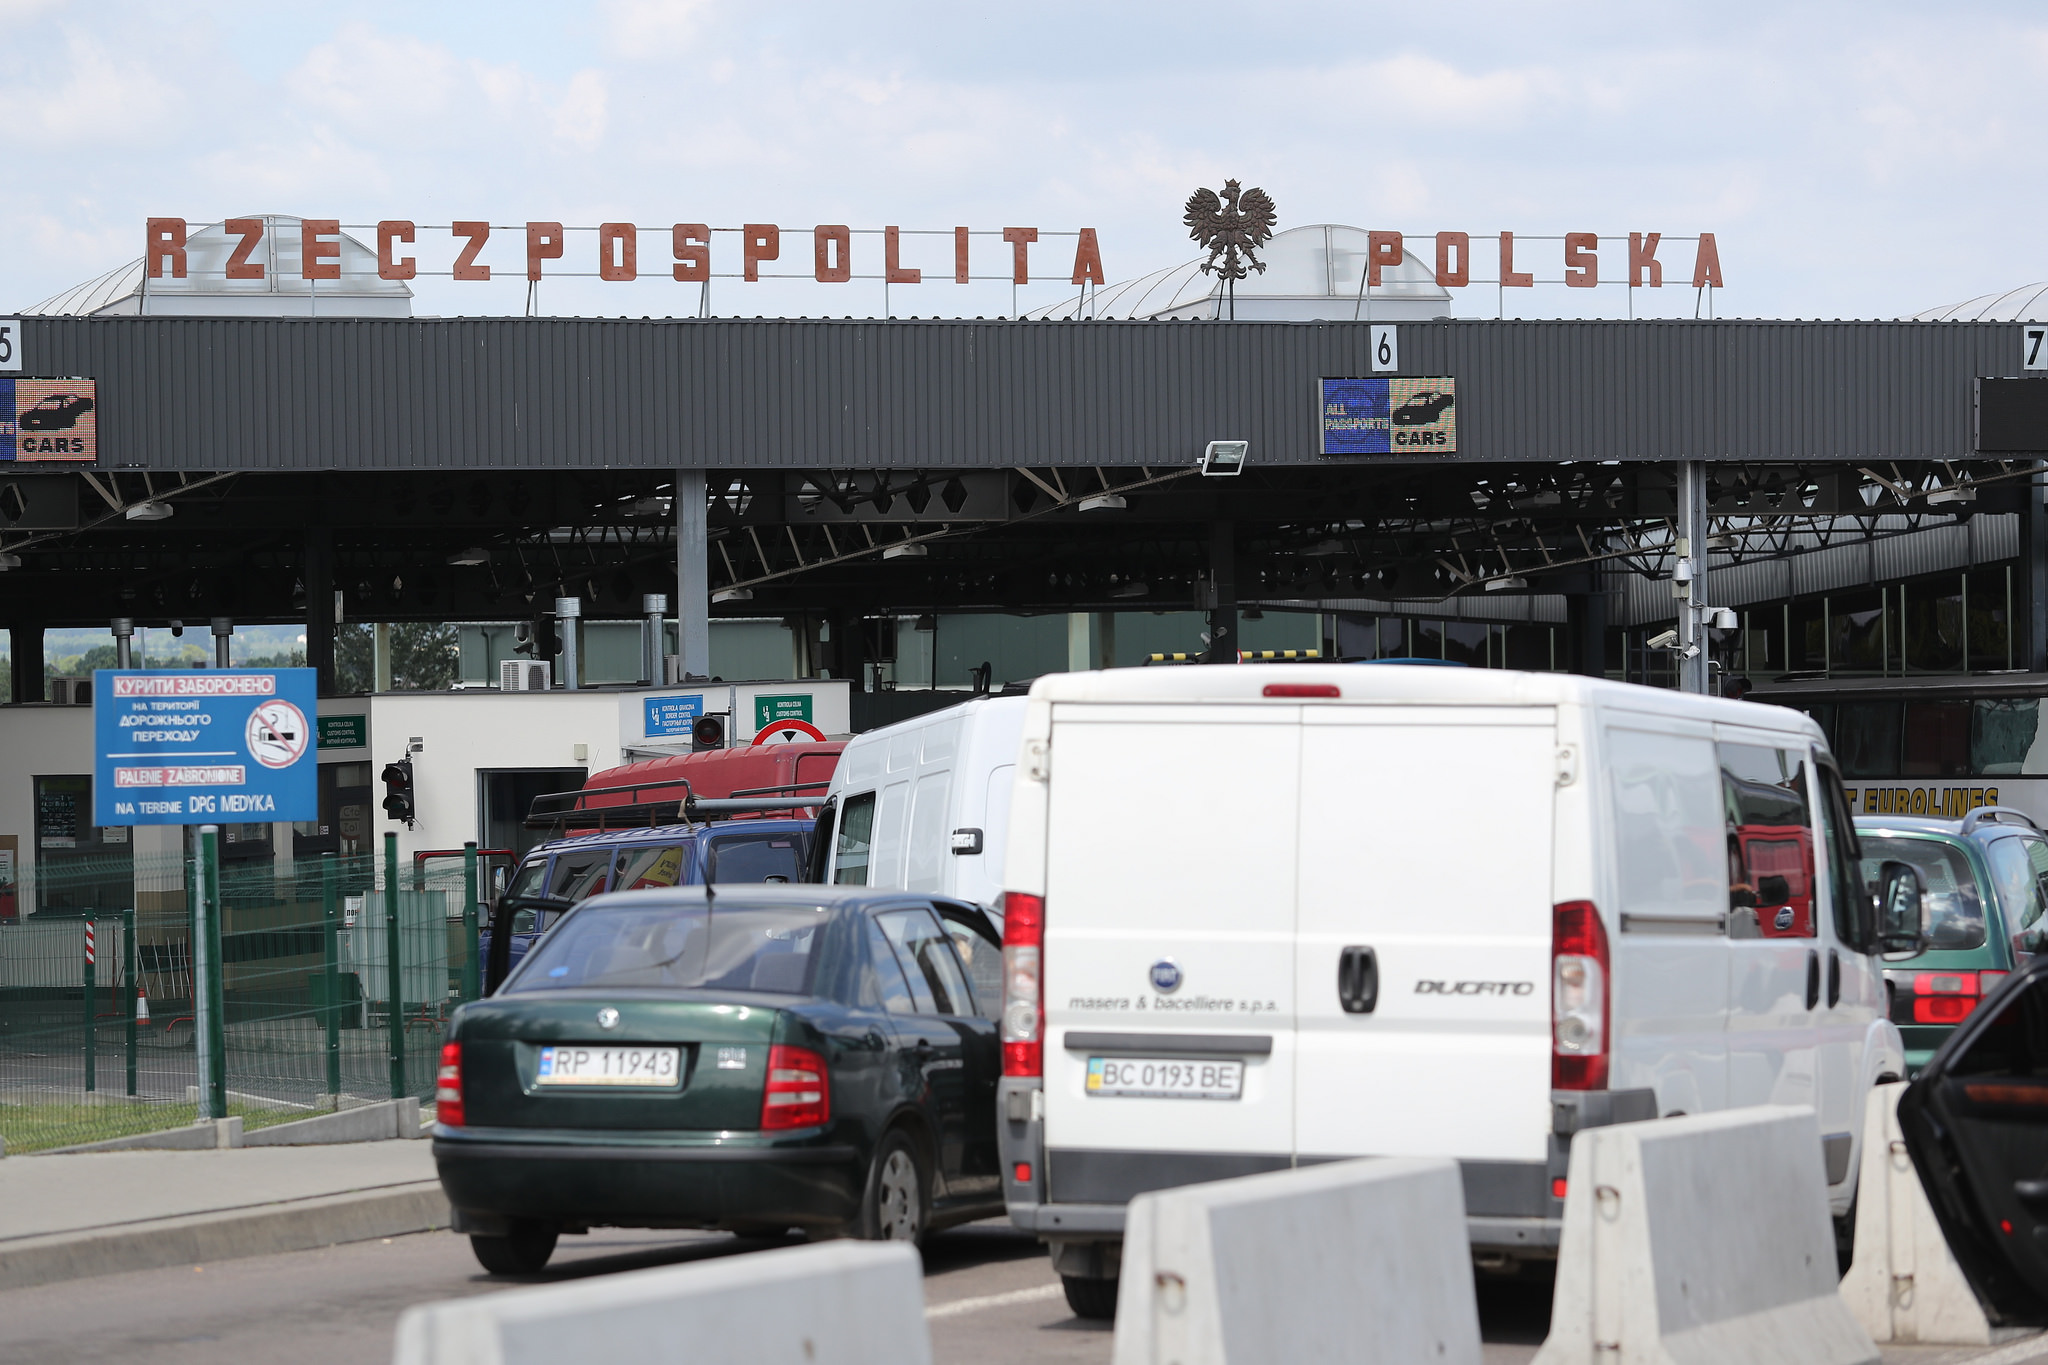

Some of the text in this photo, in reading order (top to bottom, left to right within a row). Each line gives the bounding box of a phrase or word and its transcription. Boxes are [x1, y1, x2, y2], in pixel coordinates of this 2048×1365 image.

[147, 217, 1724, 288] RZECZPOSPOLITA POLSKA
[0, 327, 12, 363] 5
[1378, 331, 1391, 365] 6
[2027, 330, 2045, 366] 7
[1325, 403, 1347, 415] ALL
[23, 437, 84, 453] CARS
[1396, 431, 1447, 446] CARS
[115, 677, 273, 694] КУРИТИ ЗАБОРОНЕНО
[132, 702, 148, 711] НА
[119, 714, 212, 727] ДОРОЖНЬОГО
[132, 730, 200, 743] ПЕРЕХОДУ
[118, 768, 240, 784] PALENIE ZABRONIONE
[115, 794, 276, 815] NA TERENIE DPG MEDYKA
[1864, 787, 1999, 820] EUROLINES
[1413, 980, 1534, 996] DUCATO
[1069, 997, 1130, 1010] masera
[1136, 996, 1147, 1010] &
[1154, 997, 1234, 1011] bacelliere
[556, 1050, 590, 1075] RP
[602, 1050, 673, 1076] 11943
[1103, 1063, 1135, 1086] BC
[1142, 1064, 1195, 1087] 0193
[1201, 1065, 1235, 1089] BE
